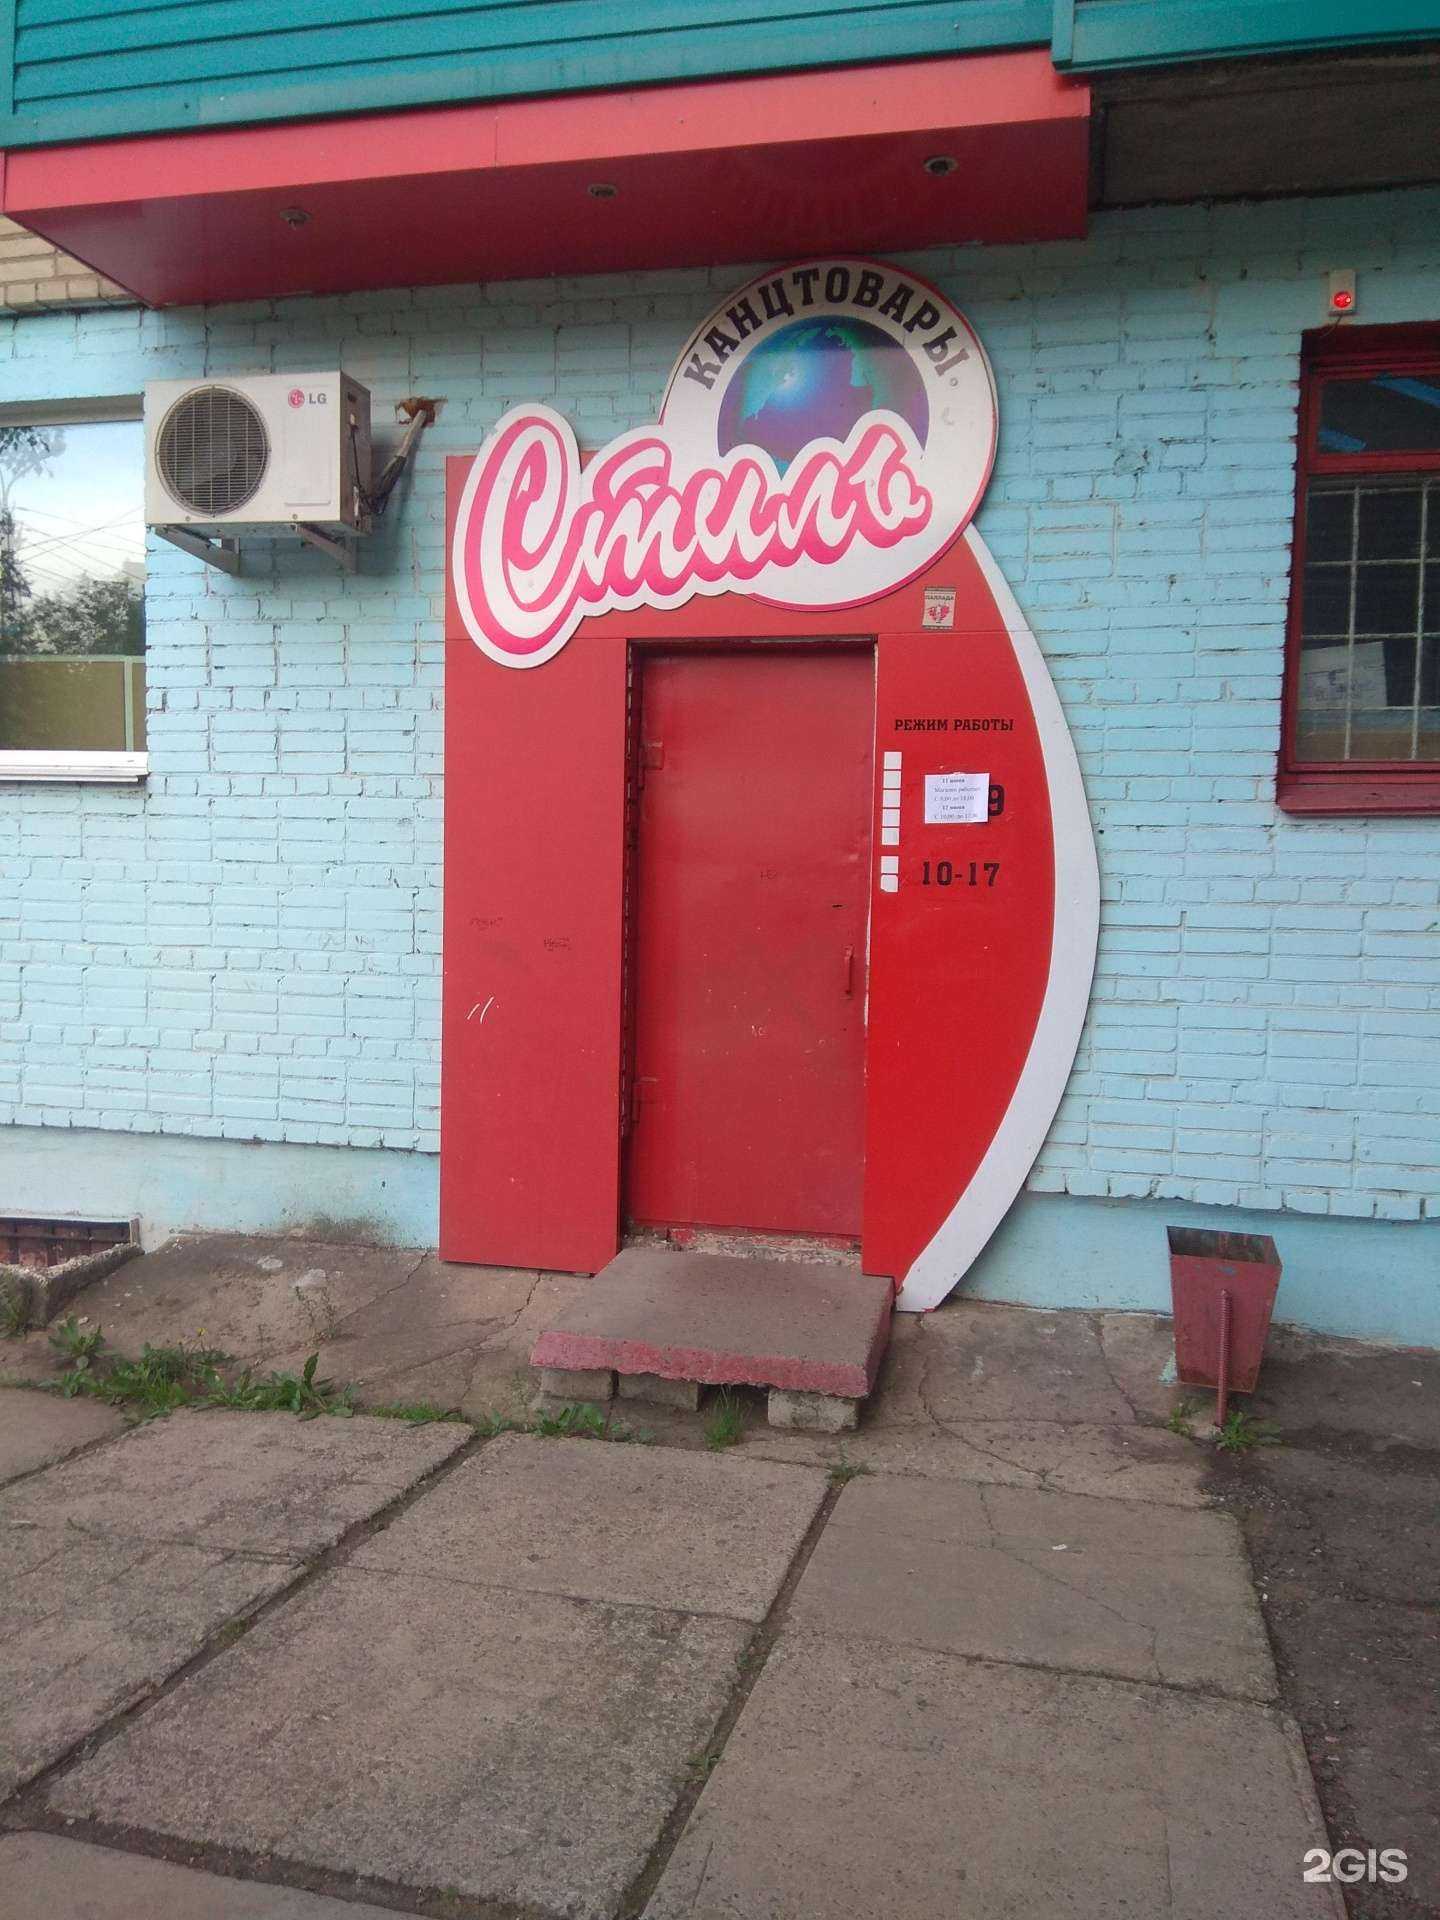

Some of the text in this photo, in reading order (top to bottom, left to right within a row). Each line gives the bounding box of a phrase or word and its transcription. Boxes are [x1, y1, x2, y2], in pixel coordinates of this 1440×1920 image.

[683, 266, 971, 390] КАНЦТОВАРЫ
[309, 392, 328, 405] LG
[464, 416, 933, 656] Стиль
[895, 719, 1014, 731] РЕЖИМ РАБОТЫ
[922, 861, 1000, 887] 10-17
